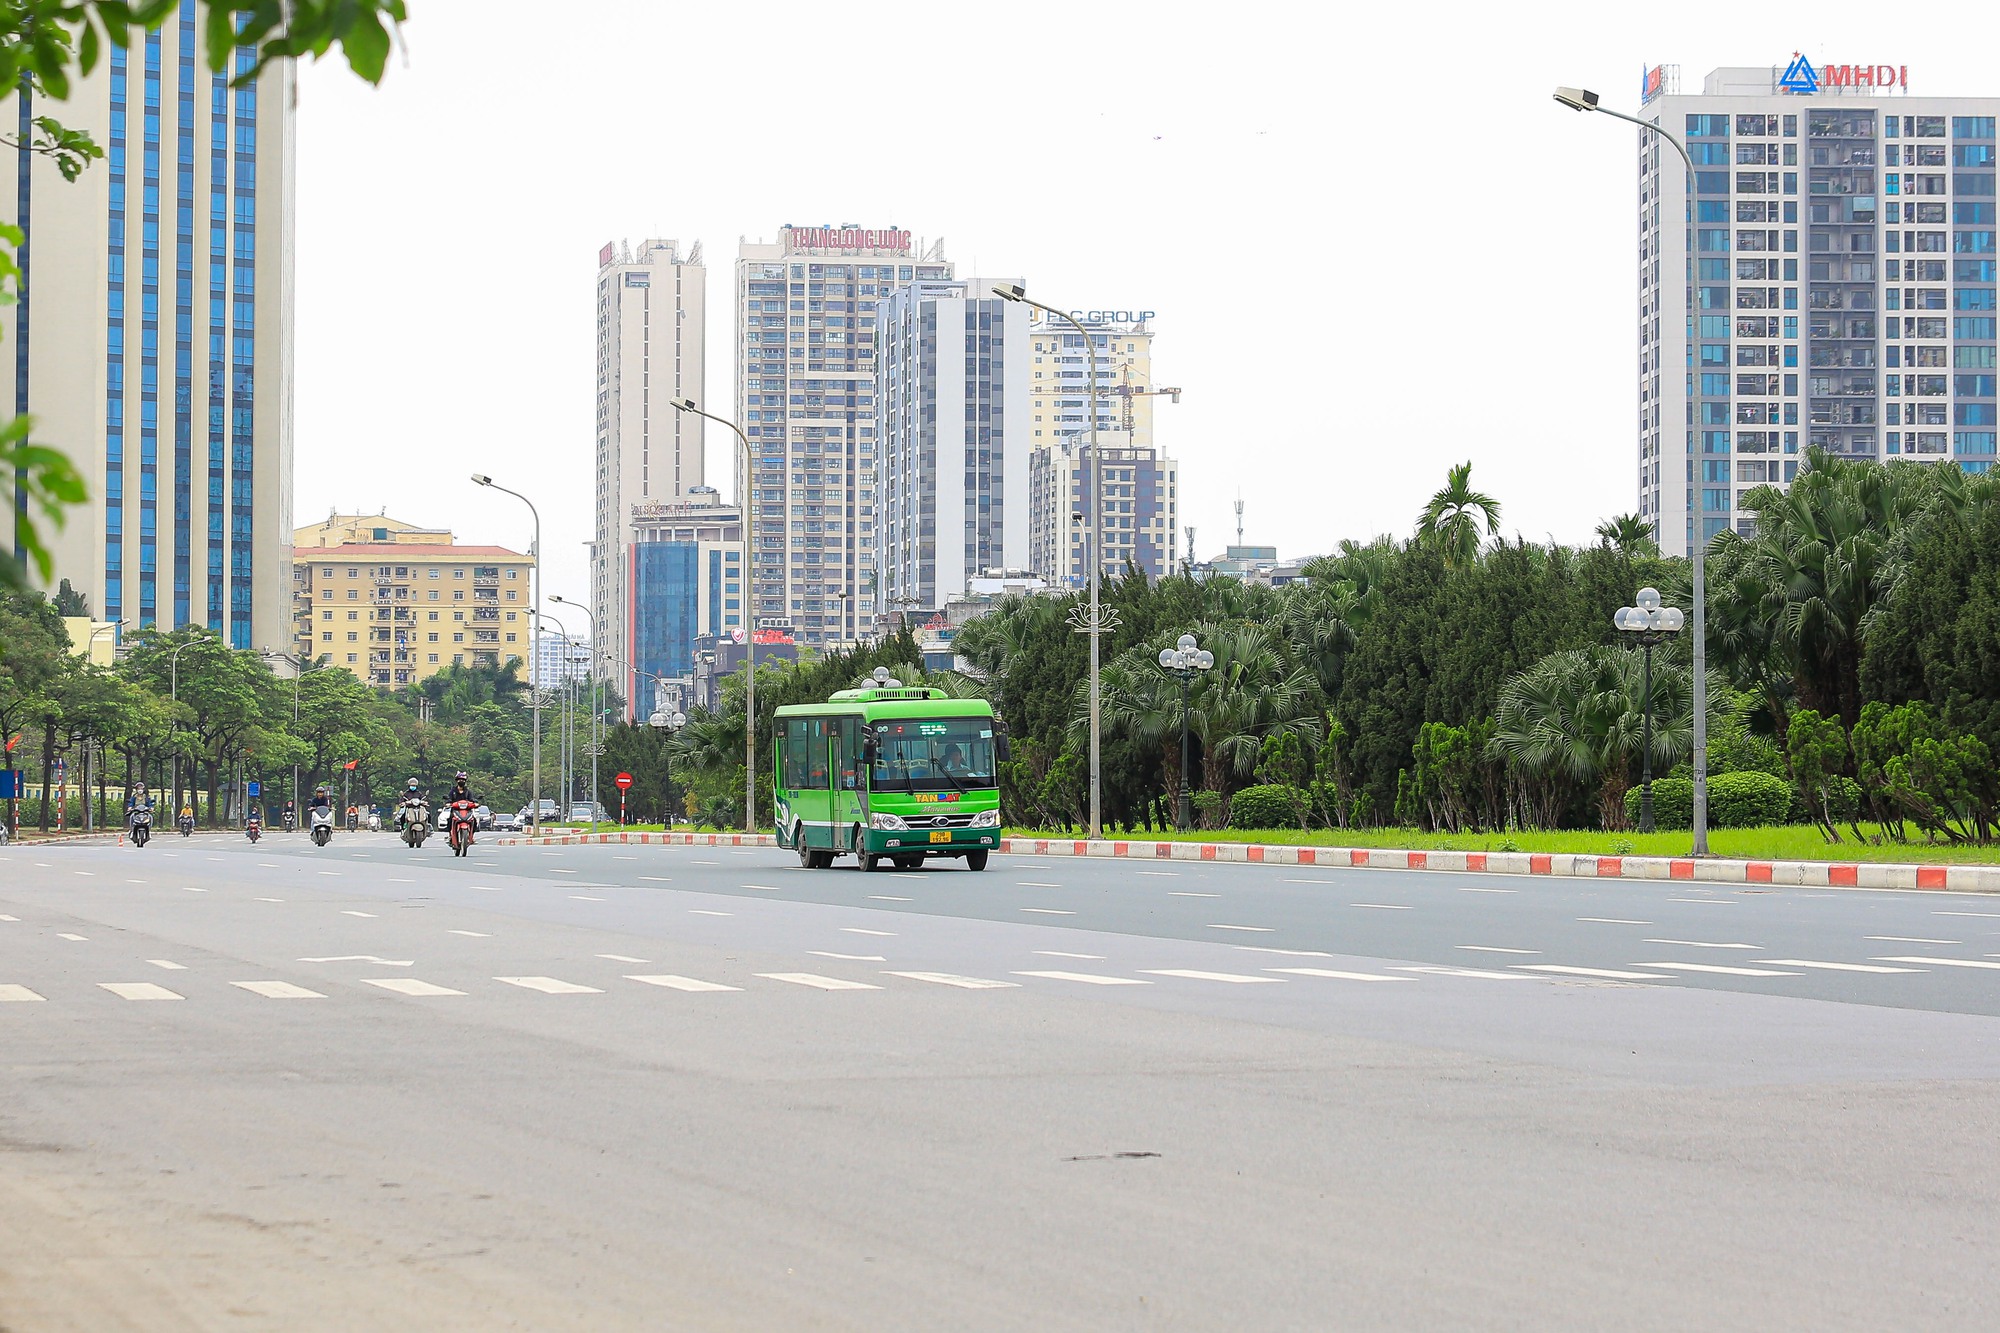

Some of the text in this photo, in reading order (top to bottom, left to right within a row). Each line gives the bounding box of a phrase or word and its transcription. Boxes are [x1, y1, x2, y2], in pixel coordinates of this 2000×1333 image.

[1824, 64, 1907, 87] MHDI
[879, 229, 911, 249] UDIC
[1087, 310, 1155, 323] GROUP
